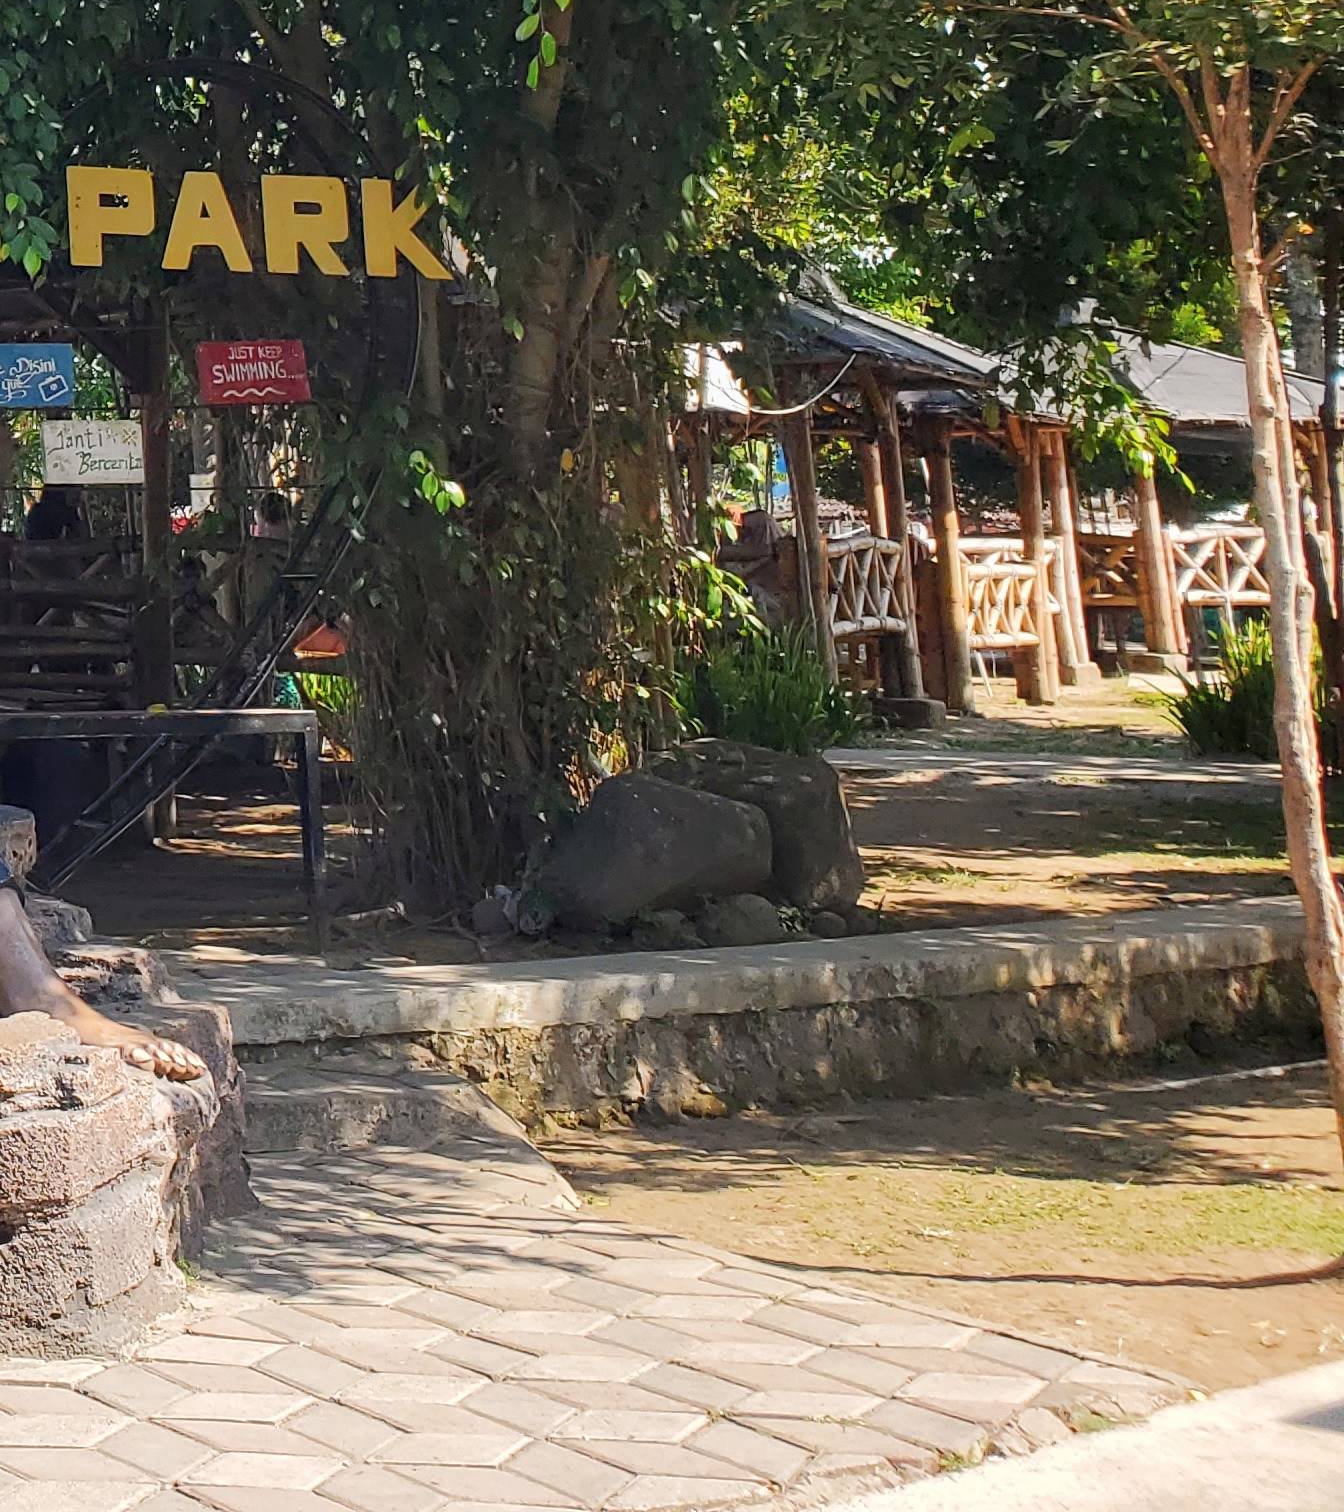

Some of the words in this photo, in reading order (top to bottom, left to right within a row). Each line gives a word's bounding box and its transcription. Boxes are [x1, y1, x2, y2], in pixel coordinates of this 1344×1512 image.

[66, 165, 453, 280] PARK
[228, 347, 254, 360] JUST
[258, 346, 282, 359] KEEP
